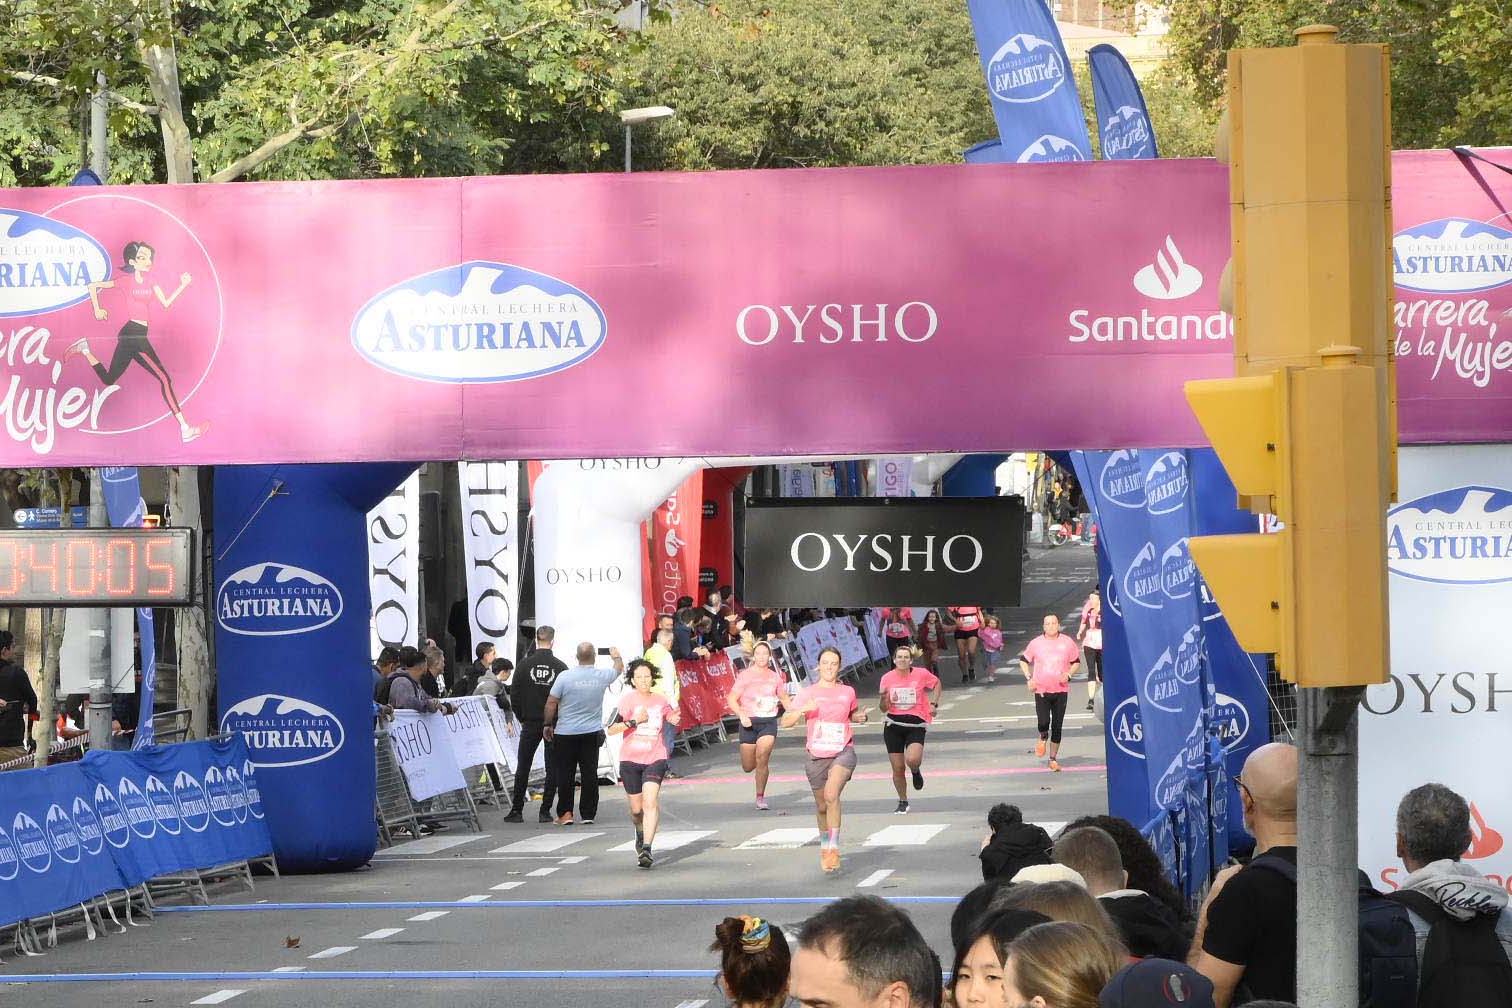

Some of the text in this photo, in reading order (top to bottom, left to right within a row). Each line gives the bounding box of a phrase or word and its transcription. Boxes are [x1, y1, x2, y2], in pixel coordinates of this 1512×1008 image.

[498, 301, 578, 314] LECHERA
[1394, 299, 1489, 329] arrera
[372, 311, 586, 353] ASTURIANA
[736, 301, 938, 345] OYSHO
[1416, 520, 1483, 531] CENTRAL
[790, 533, 983, 573] OYSHO
[546, 566, 622, 585] OYSHO
[233, 587, 329, 596] CENTRAL LECHERA
[221, 591, 334, 620] ASTURIANA
[536, 669, 549, 678] BP
[235, 719, 330, 728] CENTRAL LECHERA
[226, 726, 334, 749] TURIANA
